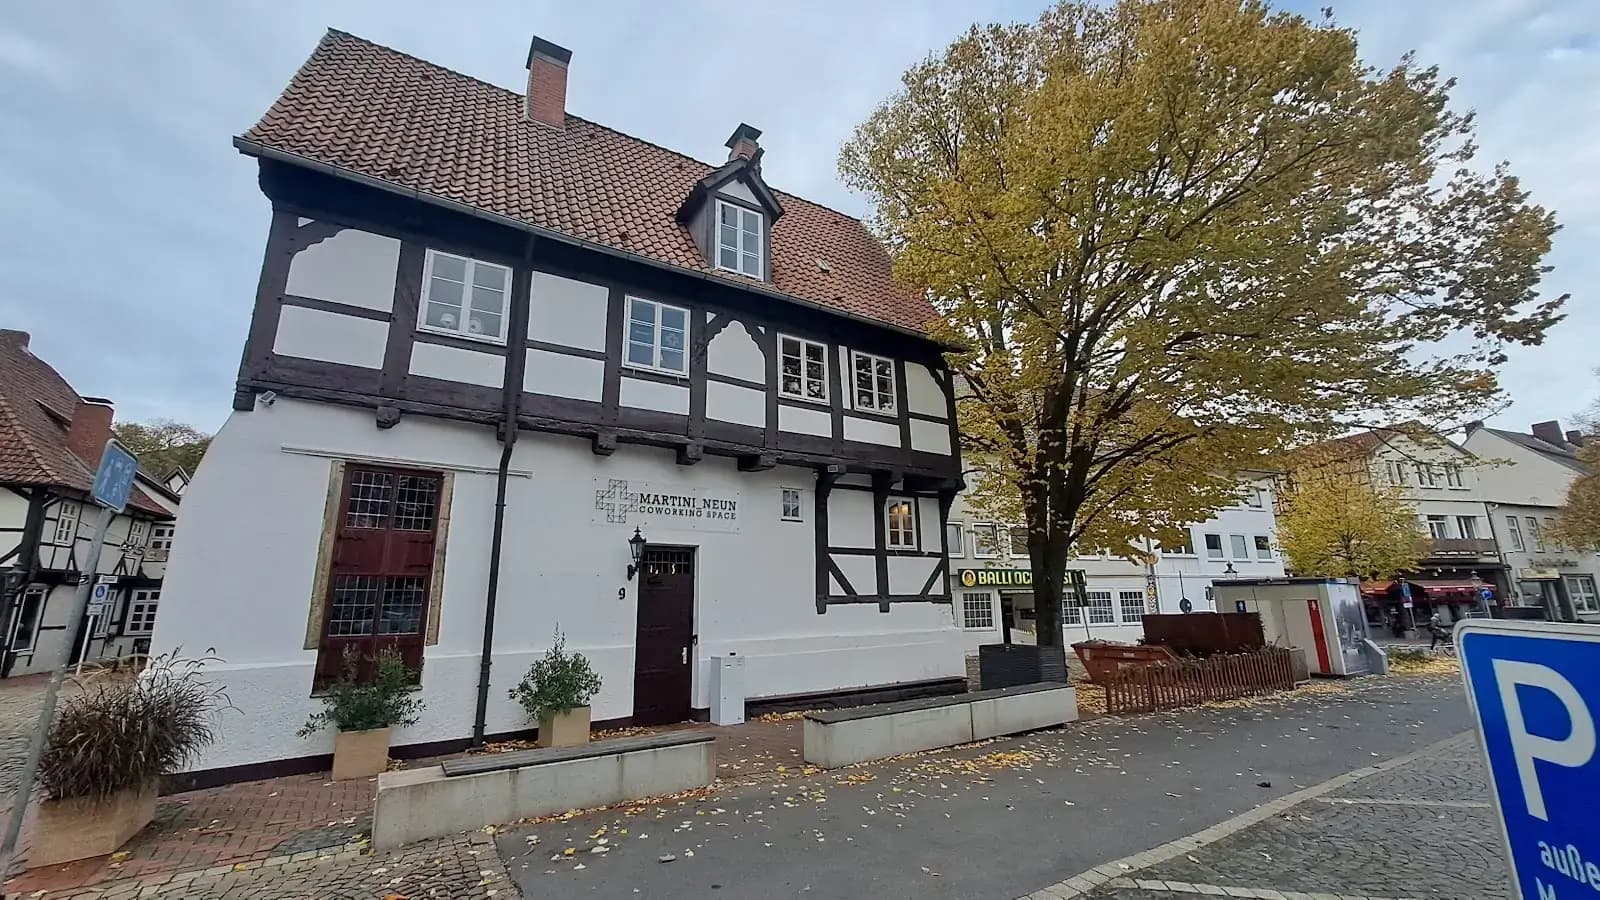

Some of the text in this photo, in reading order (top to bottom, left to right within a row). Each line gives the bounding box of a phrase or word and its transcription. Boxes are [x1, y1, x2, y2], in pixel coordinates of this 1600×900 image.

[640, 506, 736, 520] COWORKING SPACE
[978, 571, 1012, 585] BALLI
[618, 587, 626, 600] 9
[1491, 658, 1596, 822] P
